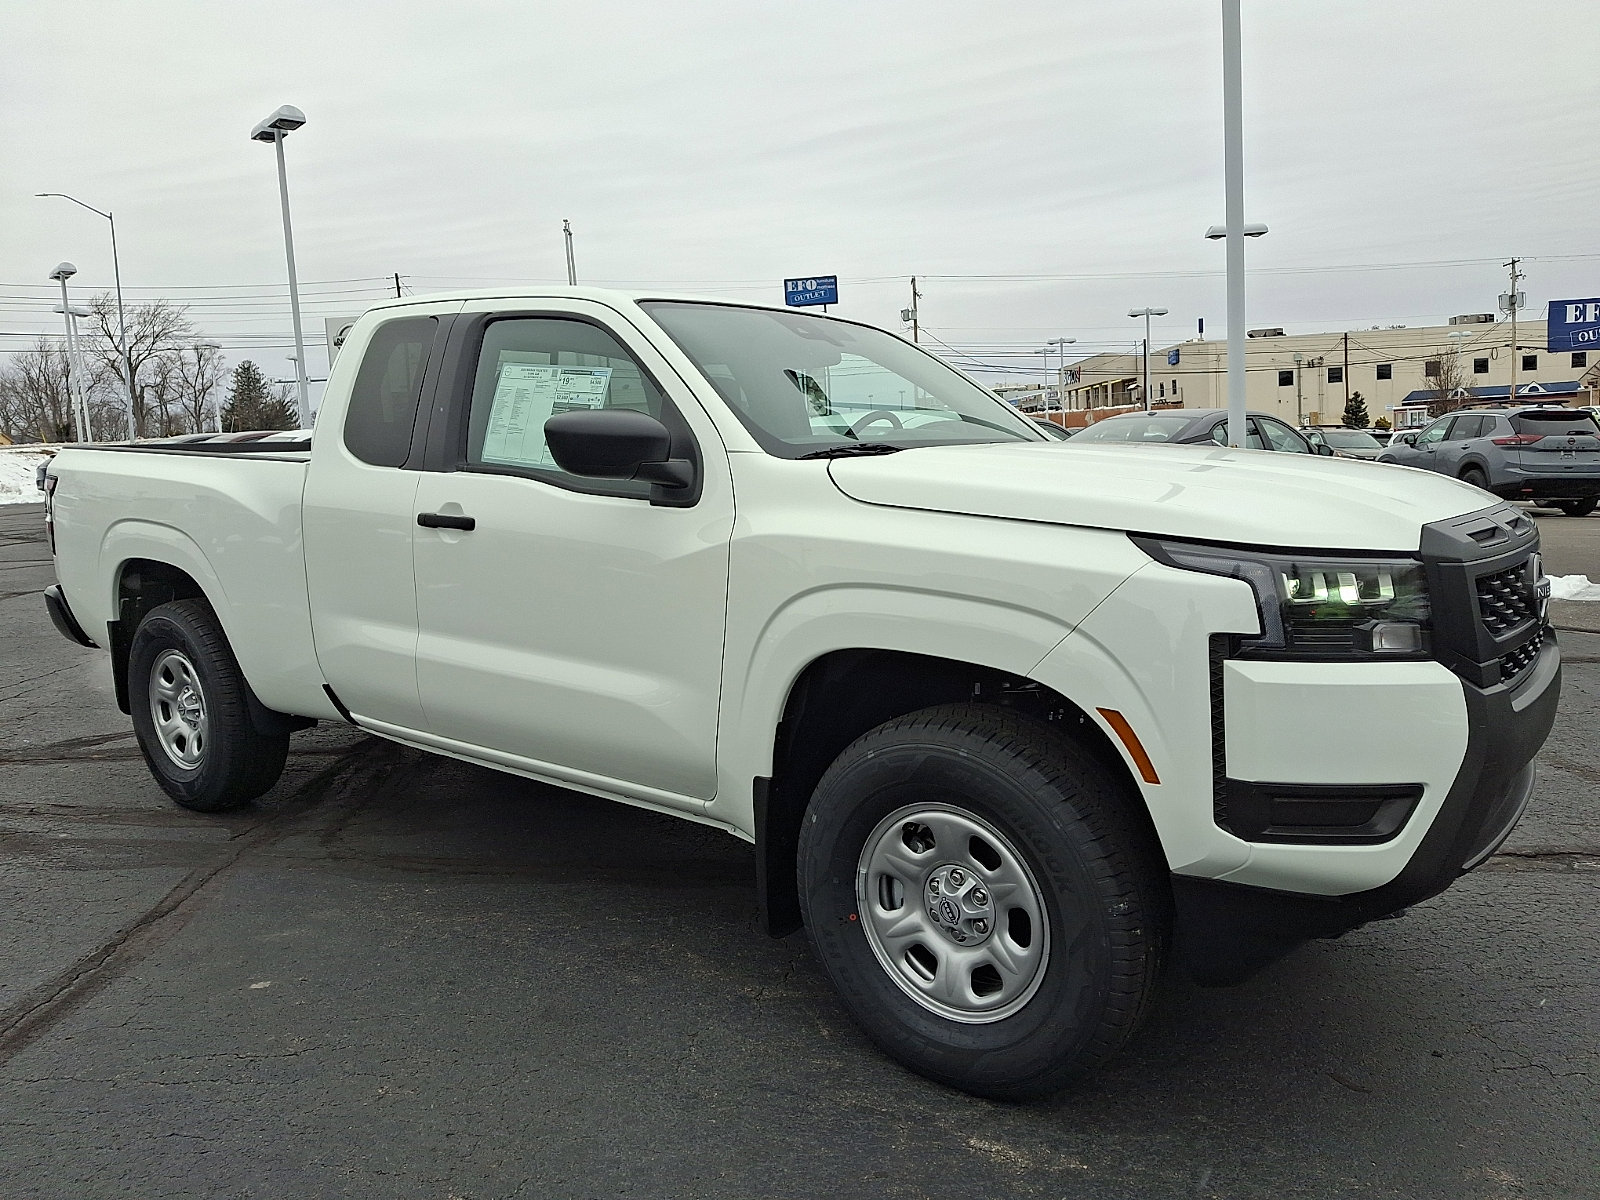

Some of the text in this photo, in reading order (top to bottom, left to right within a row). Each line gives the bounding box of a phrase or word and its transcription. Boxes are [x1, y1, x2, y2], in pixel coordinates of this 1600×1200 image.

[786, 280, 817, 292] EFO
[794, 290, 826, 302] OUTLET
[1564, 303, 1600, 324] EF
[1578, 329, 1600, 342] OU
[562, 377, 570, 385] 19
